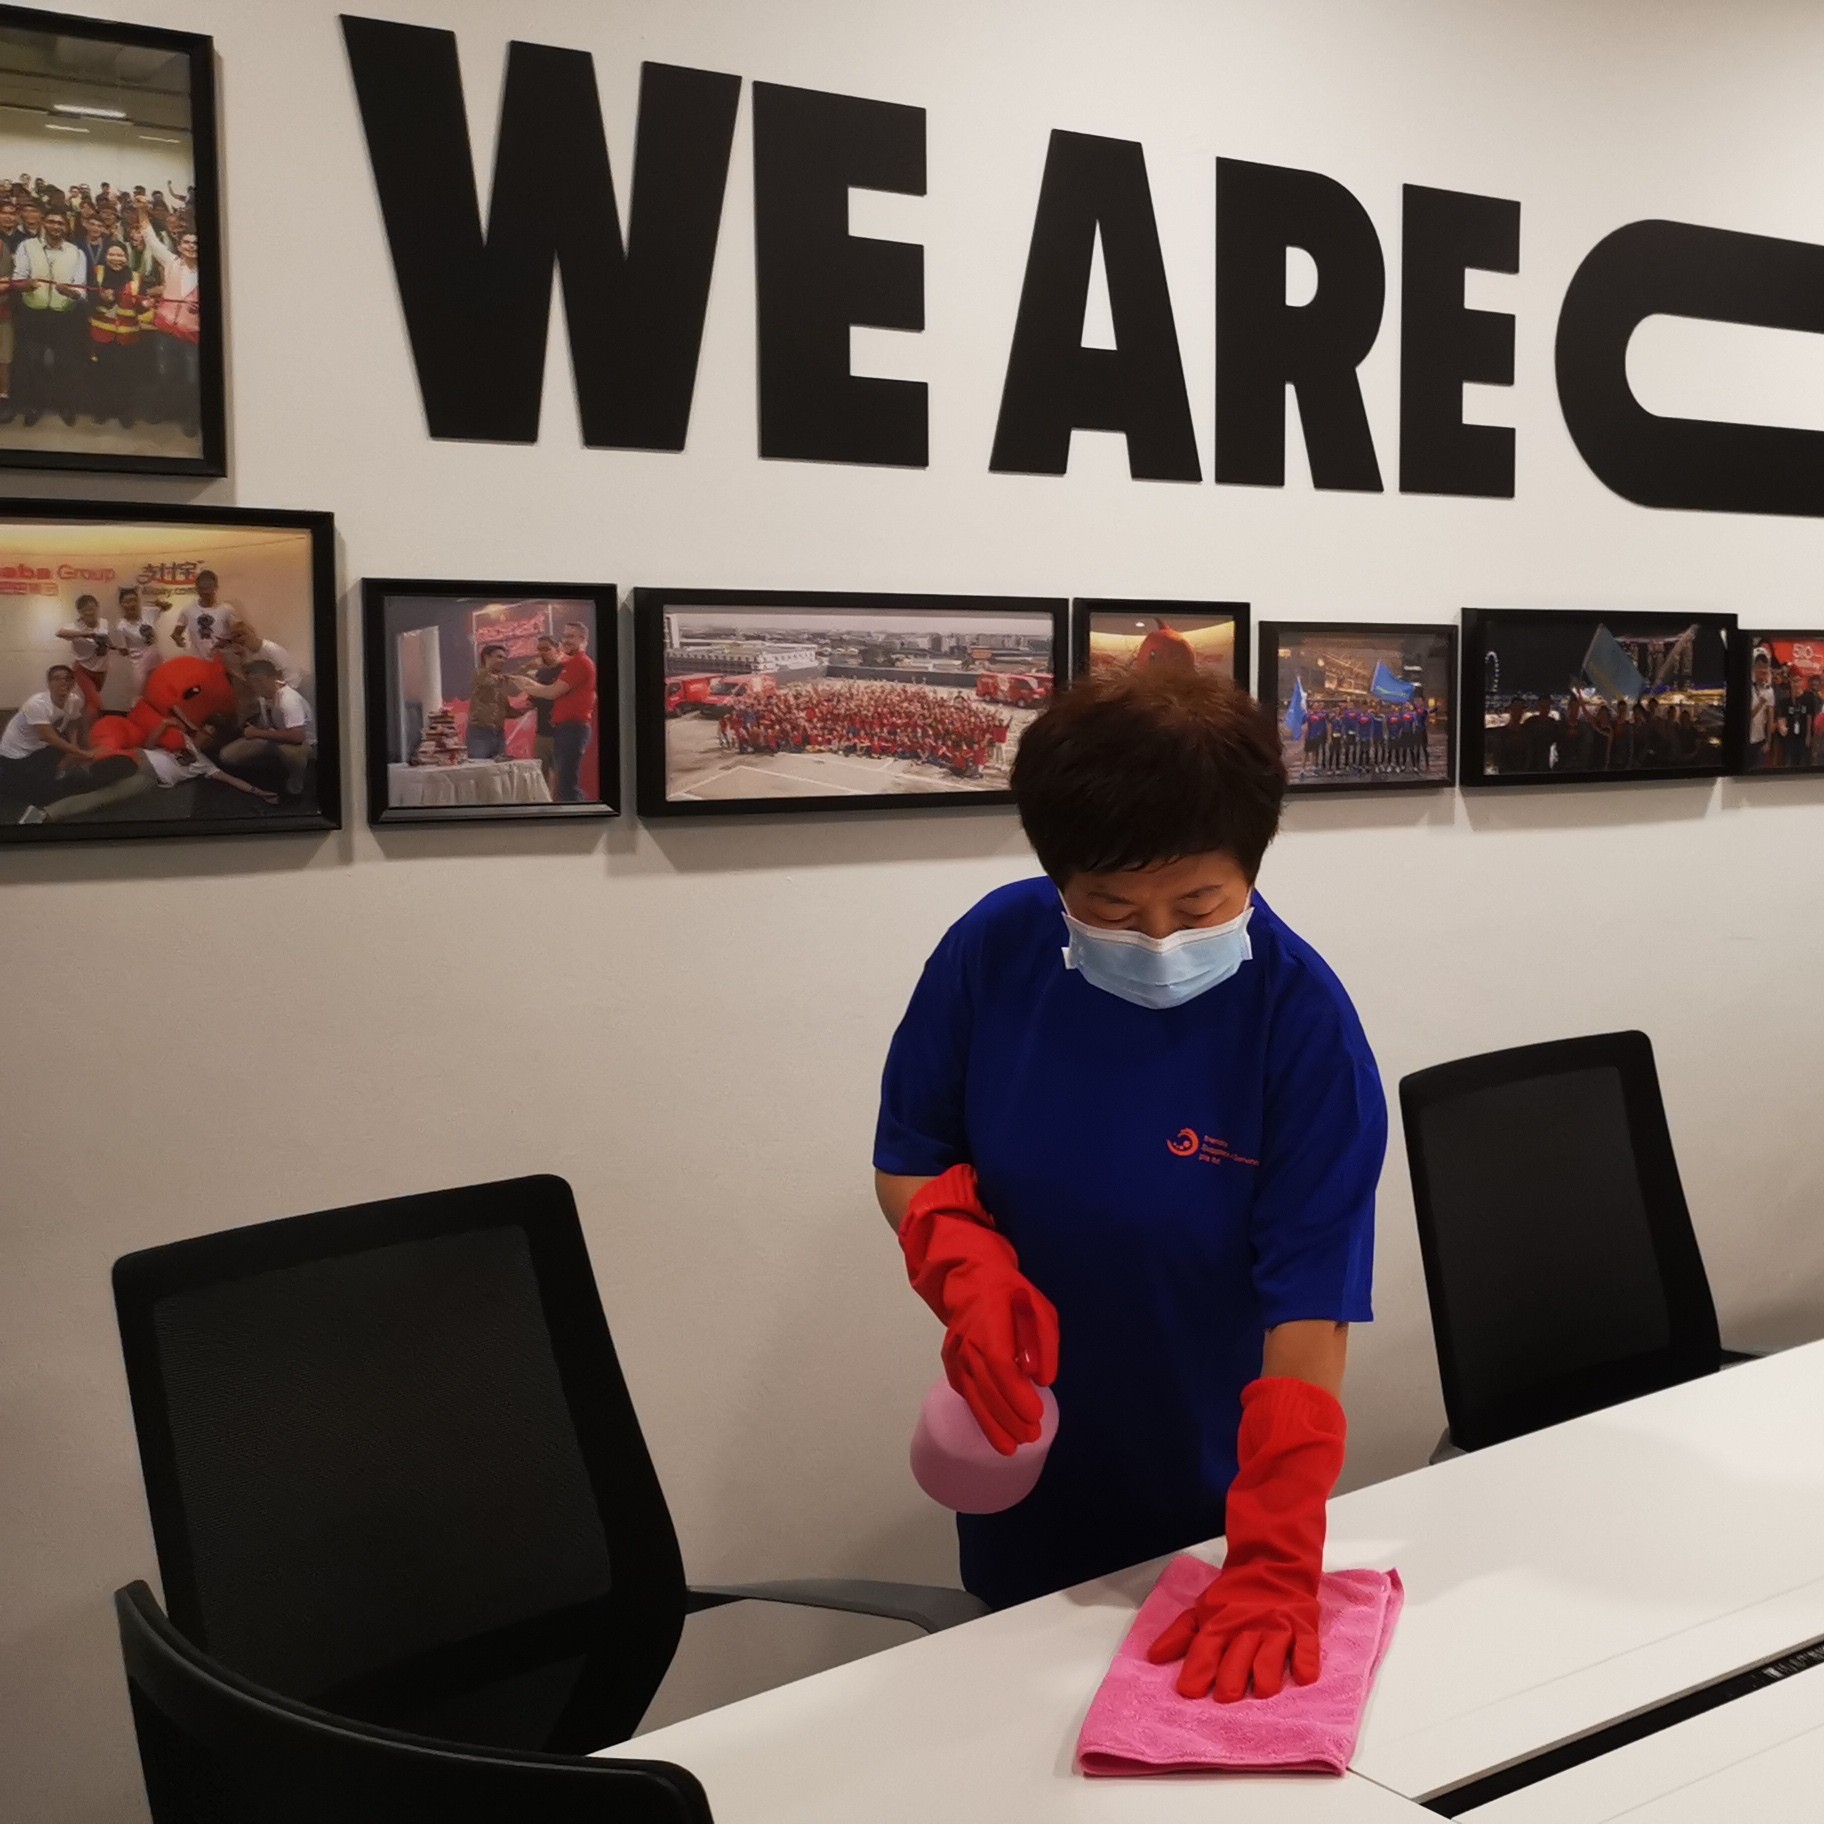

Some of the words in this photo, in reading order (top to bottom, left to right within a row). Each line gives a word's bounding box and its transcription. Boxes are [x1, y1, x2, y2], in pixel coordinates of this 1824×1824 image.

[339, 13, 929, 468] WE
[988, 128, 1521, 499] ARE
[57, 564, 116, 582] Group
